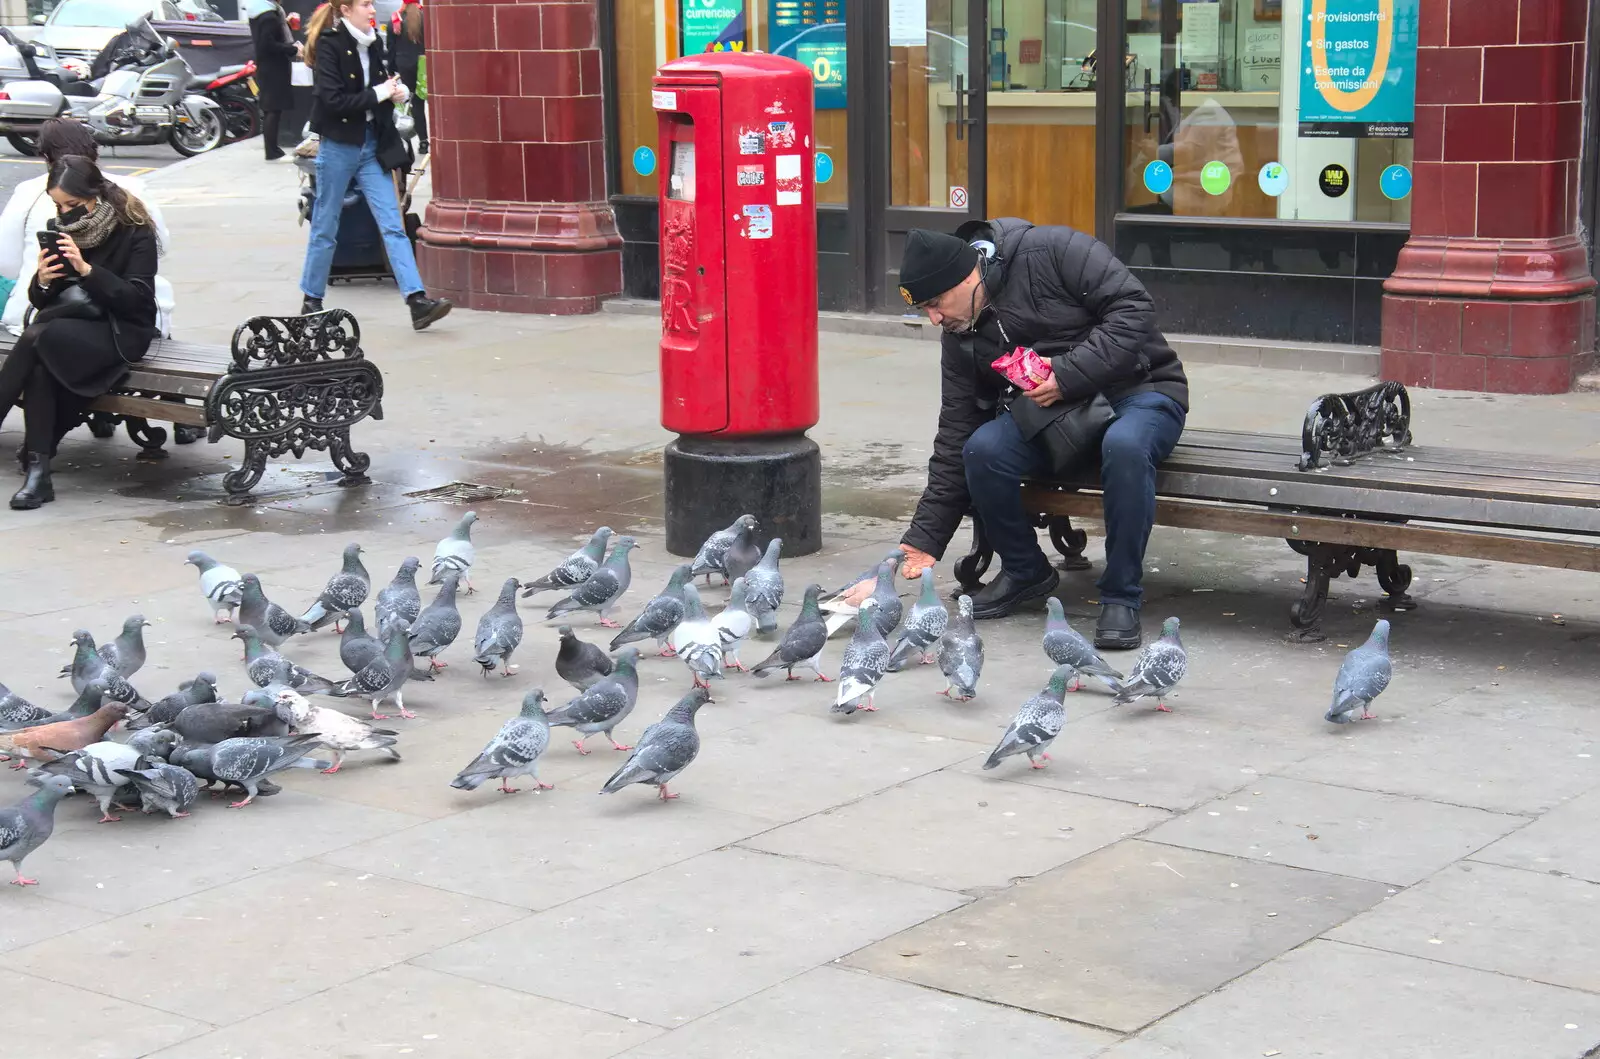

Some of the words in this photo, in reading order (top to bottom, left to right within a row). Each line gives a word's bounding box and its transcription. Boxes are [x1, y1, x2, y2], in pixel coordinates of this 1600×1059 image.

[686, 7, 736, 19] currencies
[1317, 10, 1386, 22] Provisionsfrei
[1316, 39, 1332, 49] Sin
[1335, 39, 1369, 51] gastos
[1315, 66, 1349, 76] Esente
[1352, 66, 1366, 76] da
[1314, 79, 1378, 90] commissioni
[1375, 125, 1408, 133] eurochange
